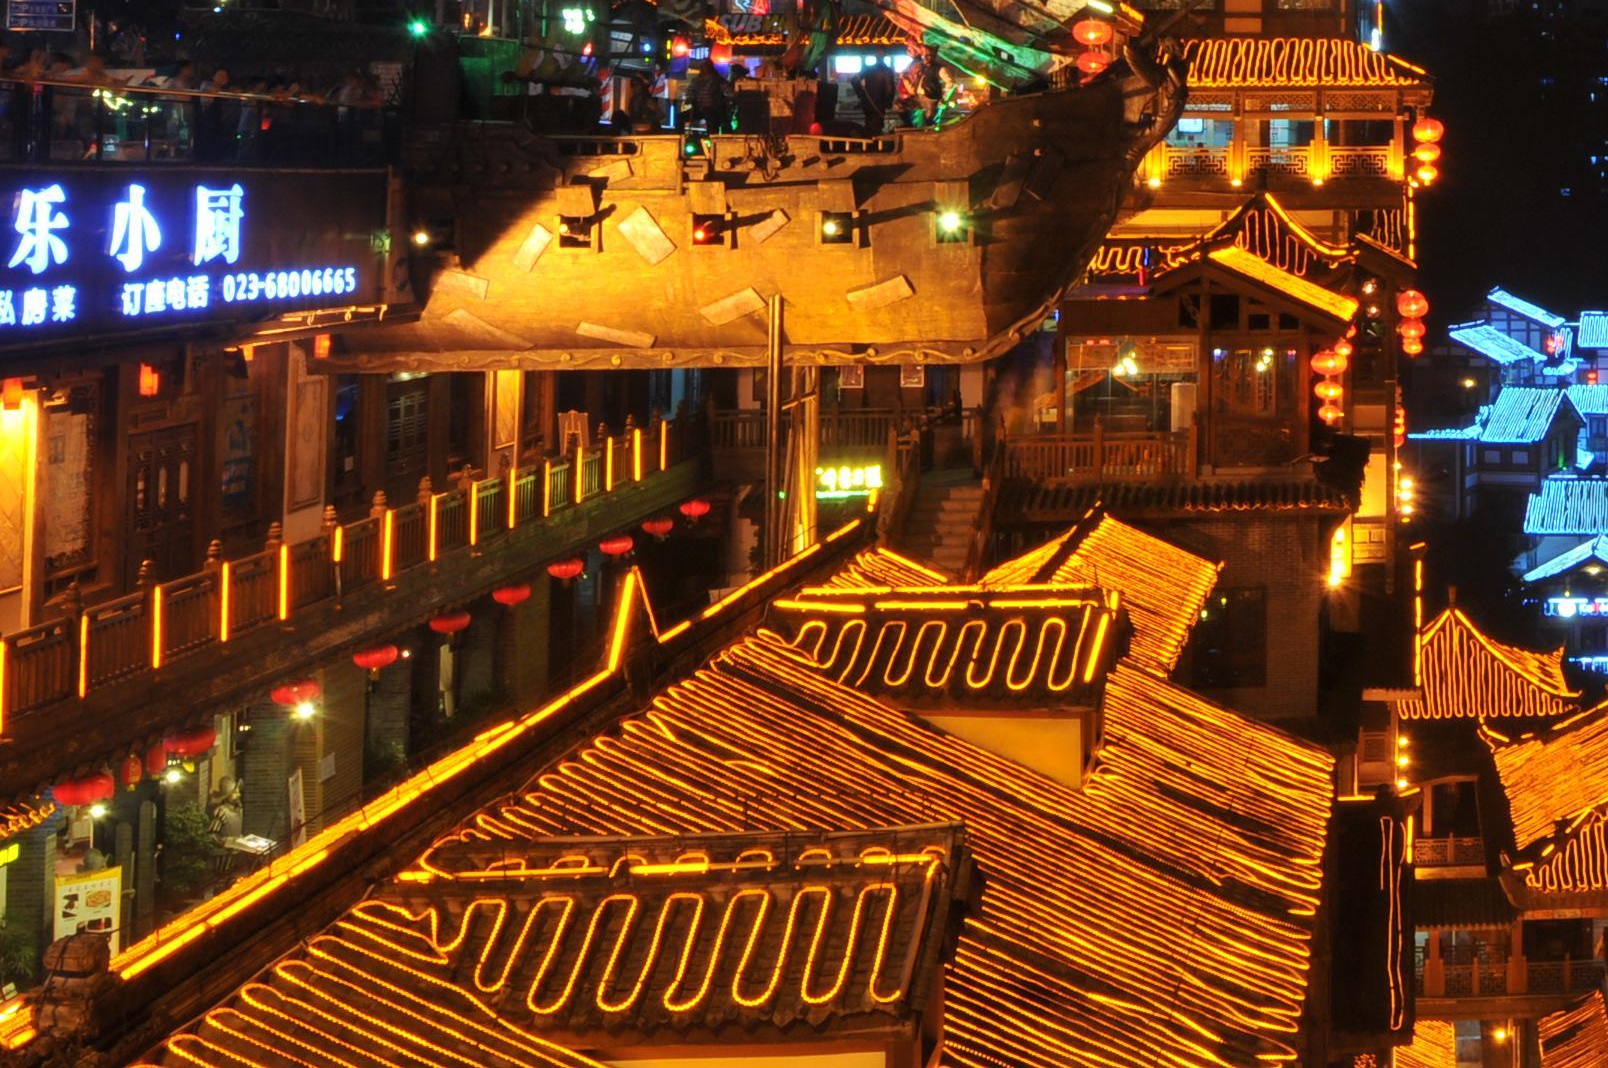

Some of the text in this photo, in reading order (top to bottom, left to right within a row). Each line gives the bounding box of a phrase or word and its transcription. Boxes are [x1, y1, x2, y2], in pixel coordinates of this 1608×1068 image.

[8, 183, 245, 275] 乐小厨
[121, 275, 210, 317] 订座电话
[223, 267, 356, 303] 023-68006665
